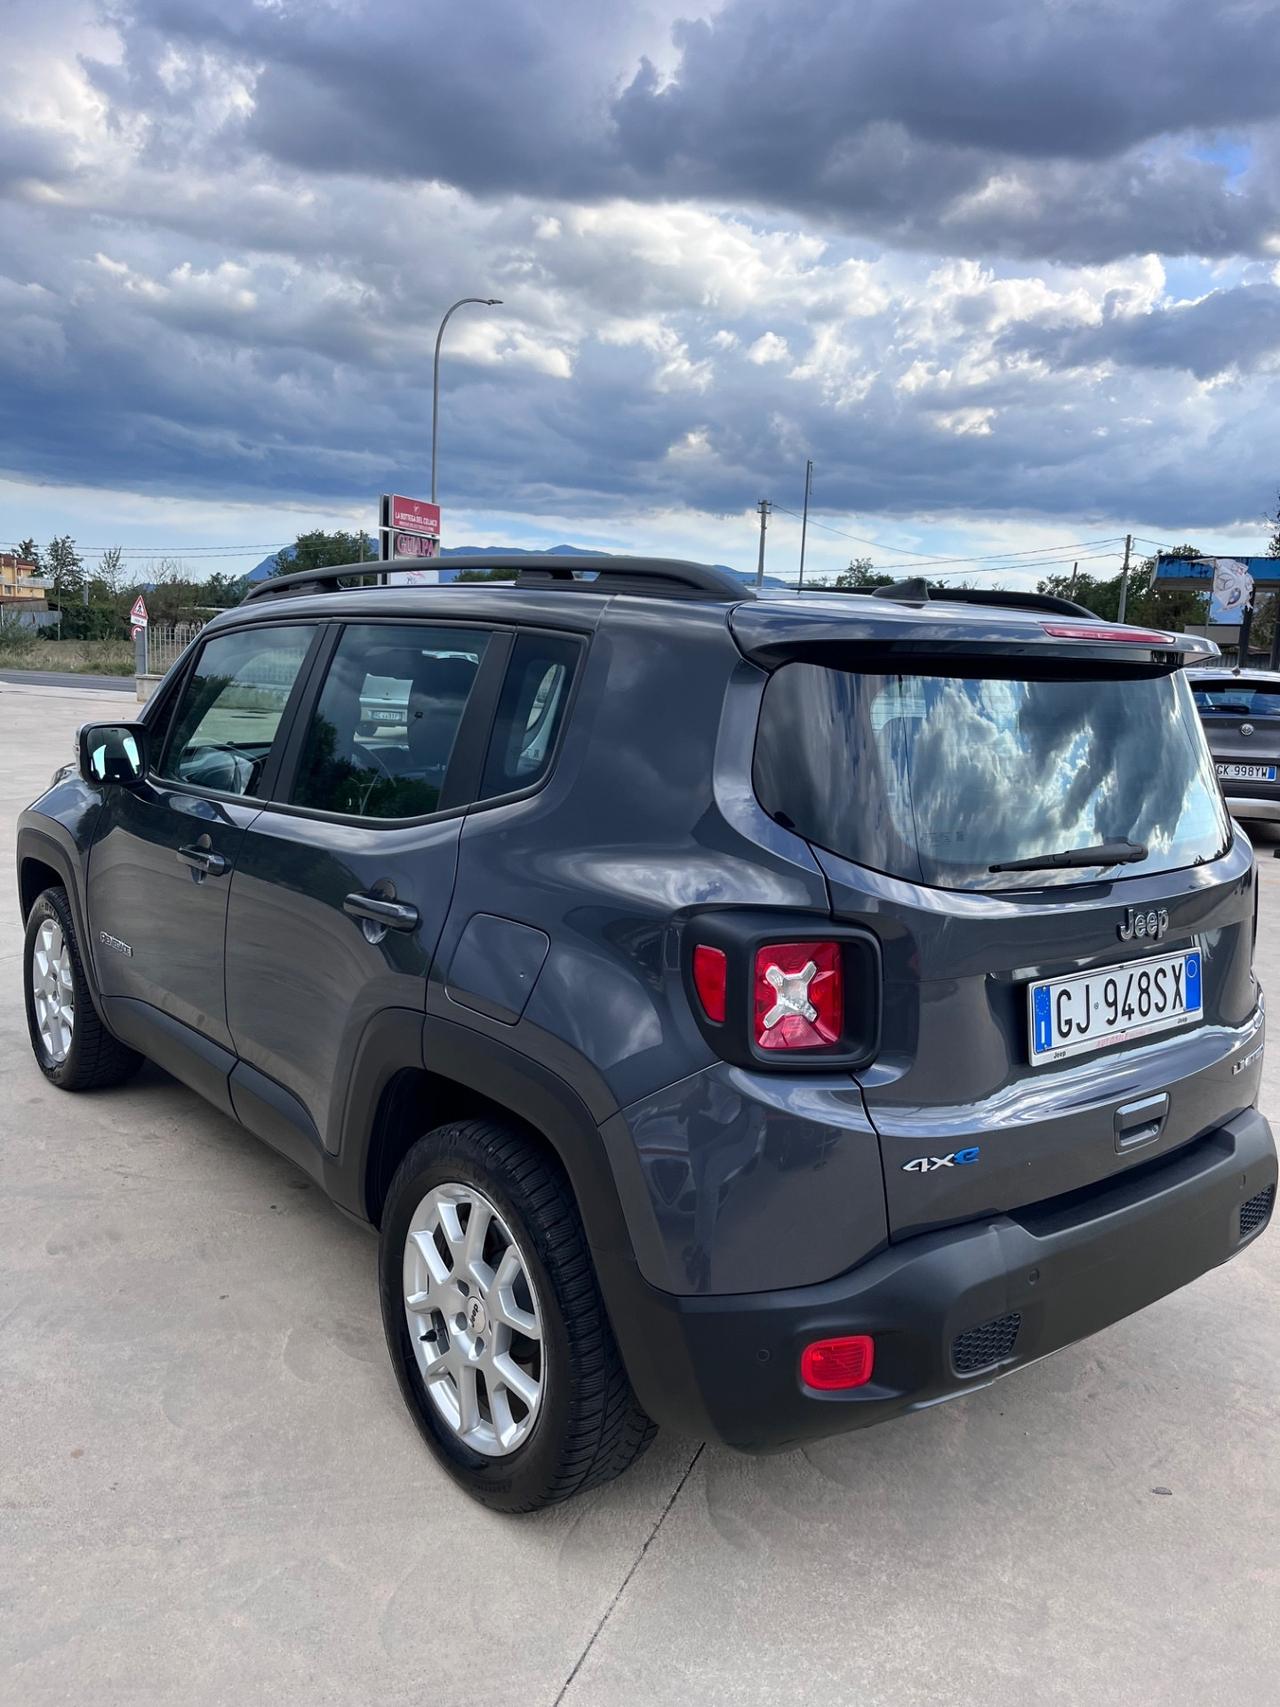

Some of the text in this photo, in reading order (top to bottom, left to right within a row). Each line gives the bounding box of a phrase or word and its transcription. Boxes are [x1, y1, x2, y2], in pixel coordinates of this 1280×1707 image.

[1216, 764, 1268, 778] GK 998YW
[1119, 908, 1169, 940] Jeep
[1056, 962, 1185, 1039] GJ 948SX
[1053, 1050, 1067, 1059] Jeep
[469, 1303, 479, 1329] Jeep
